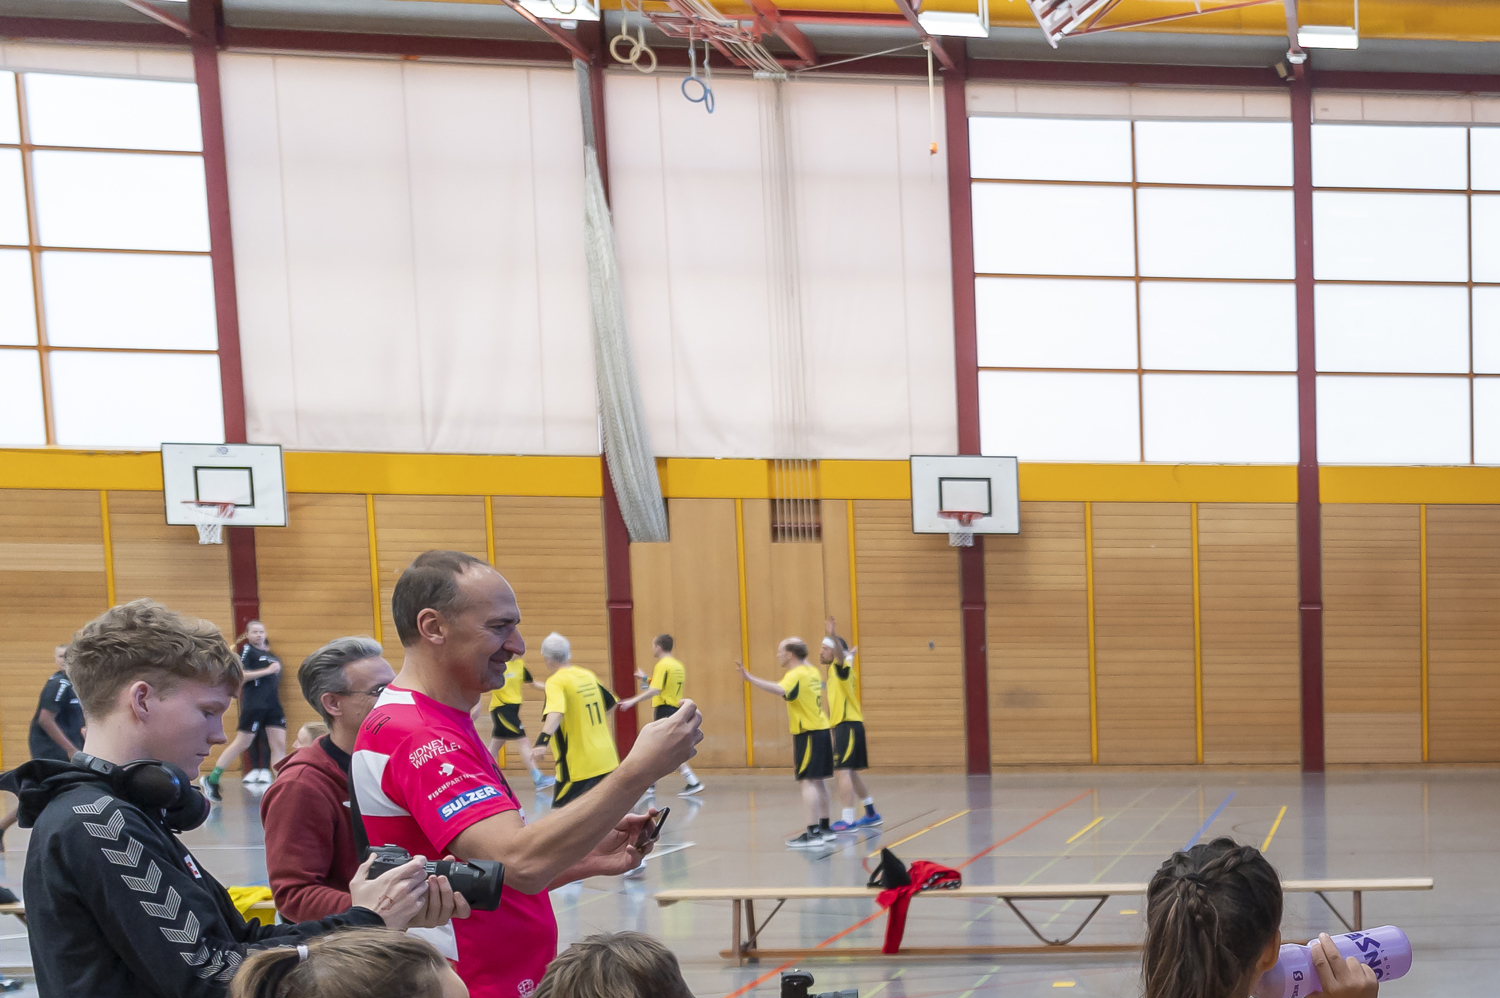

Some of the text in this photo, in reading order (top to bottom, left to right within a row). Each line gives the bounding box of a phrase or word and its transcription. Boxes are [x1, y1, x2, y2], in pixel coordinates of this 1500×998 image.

[585, 701, 602, 727] 11
[408, 737, 445, 763] SIDNEY
[412, 741, 462, 770] WINTELE
[440, 785, 498, 818] SULZER
